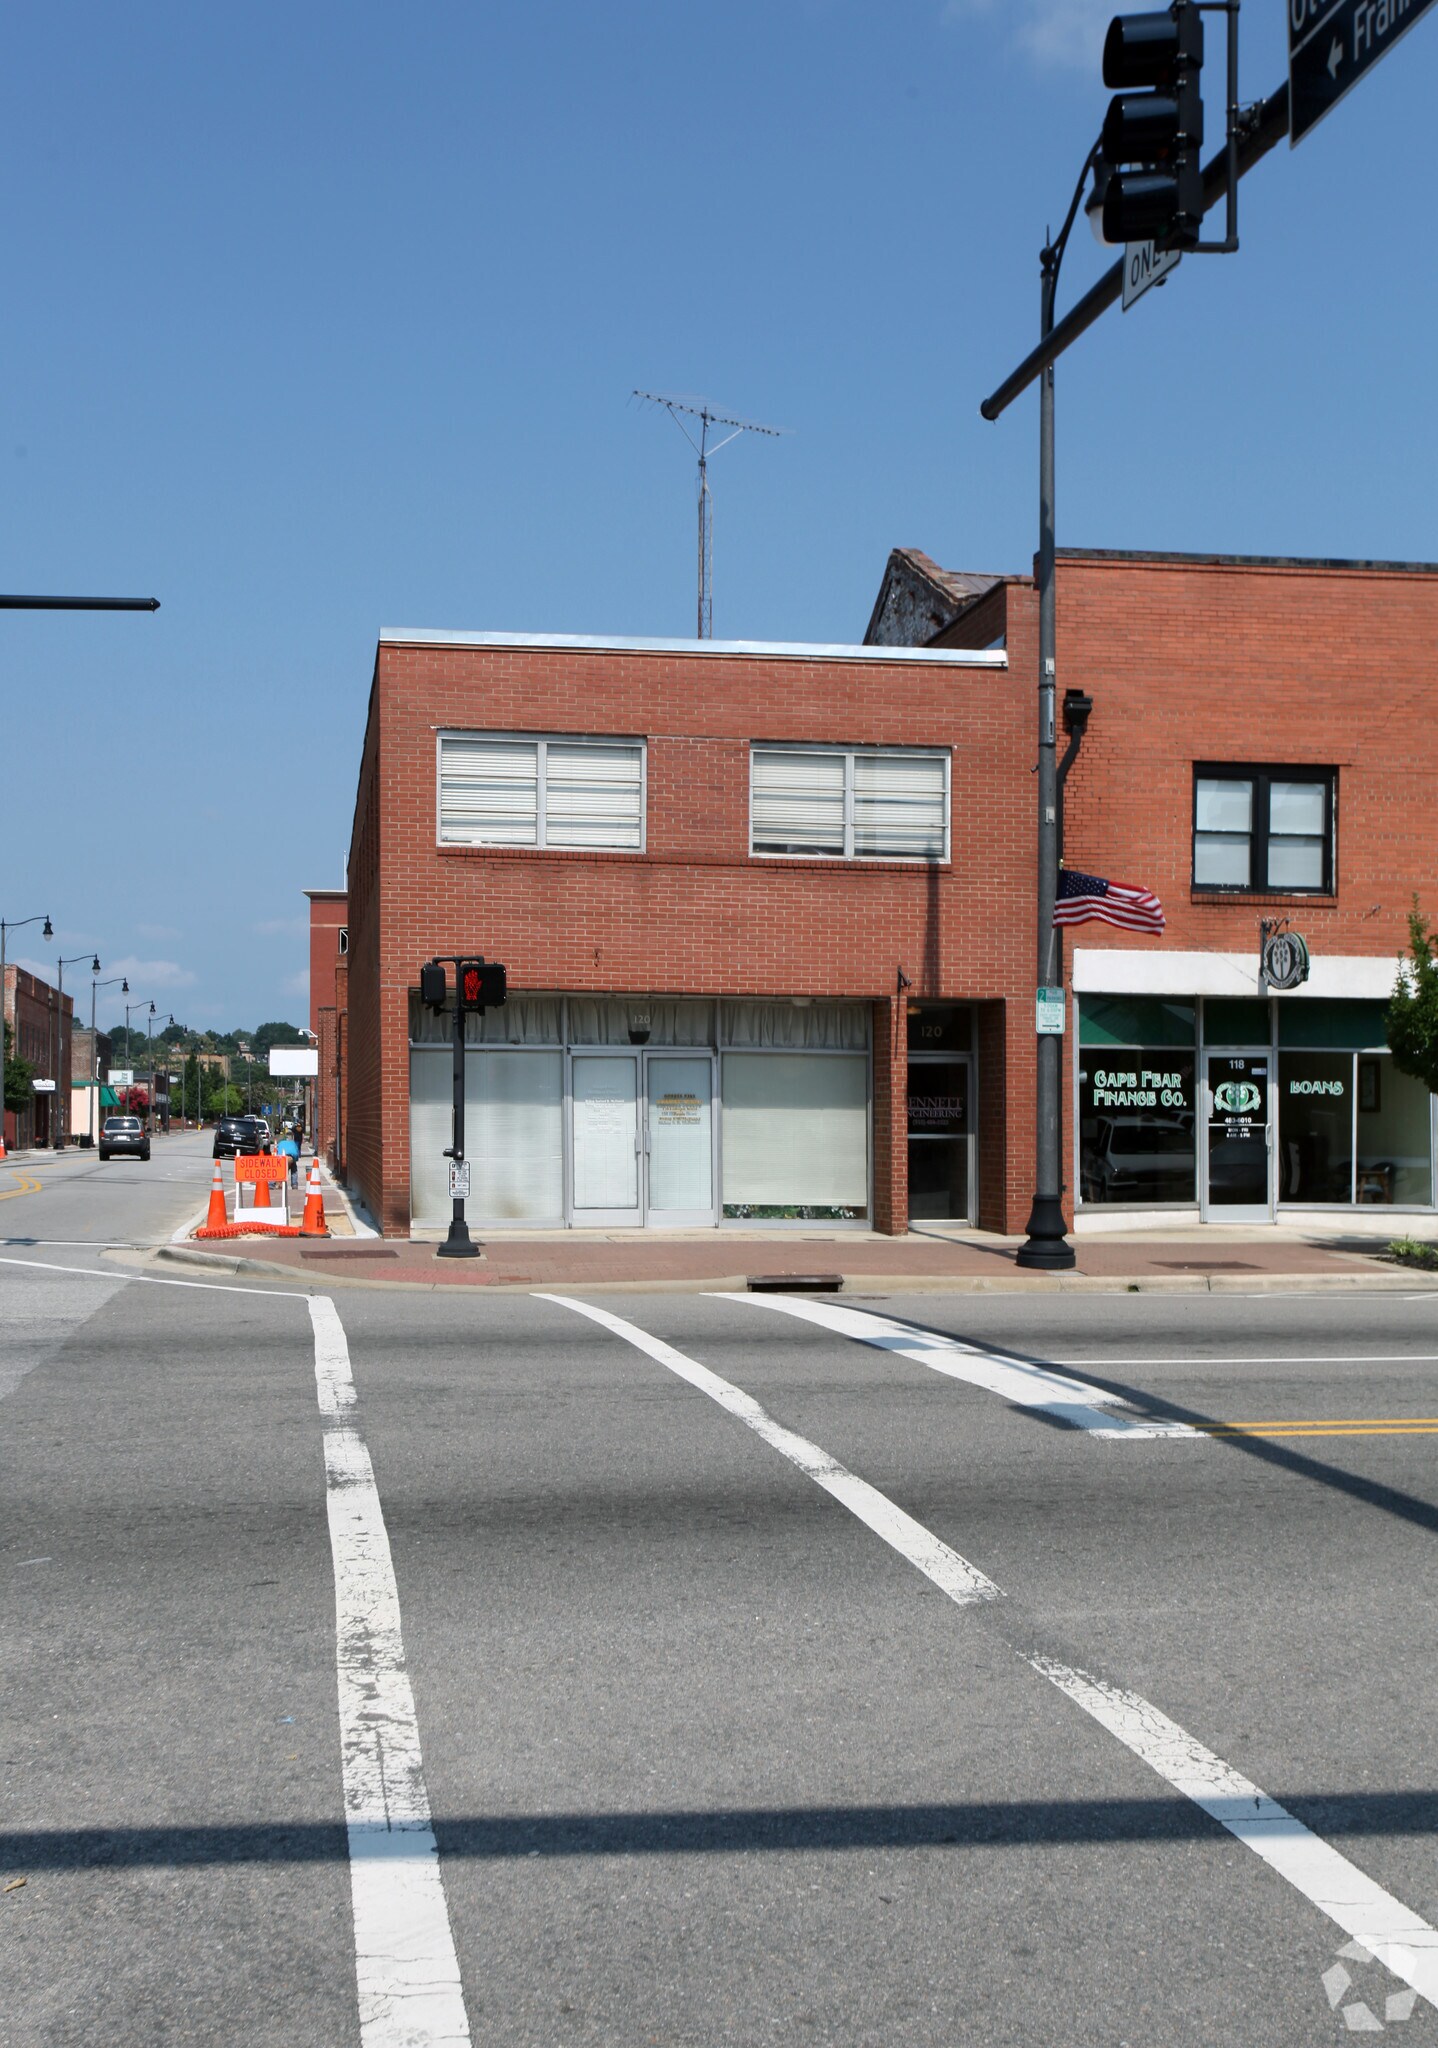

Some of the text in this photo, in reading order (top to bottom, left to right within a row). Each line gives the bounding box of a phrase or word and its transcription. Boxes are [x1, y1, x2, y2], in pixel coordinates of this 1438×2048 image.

[1354, 0, 1412, 61] Fran
[1131, 241, 1168, 287] ONL
[634, 1014, 650, 1024] 120
[921, 1026, 943, 1038] 120
[1229, 1060, 1245, 1070] 118
[1094, 1070, 1182, 1088] CAPE FEAR
[1290, 1080, 1344, 1096] LOANS
[908, 1096, 963, 1108] ENNETT
[1093, 1089, 1187, 1107] FINANCE CO.
[907, 1109, 962, 1118] NGINEERING
[240, 1160, 282, 1169] SIDEWALK
[244, 1169, 277, 1179] CLOSED
